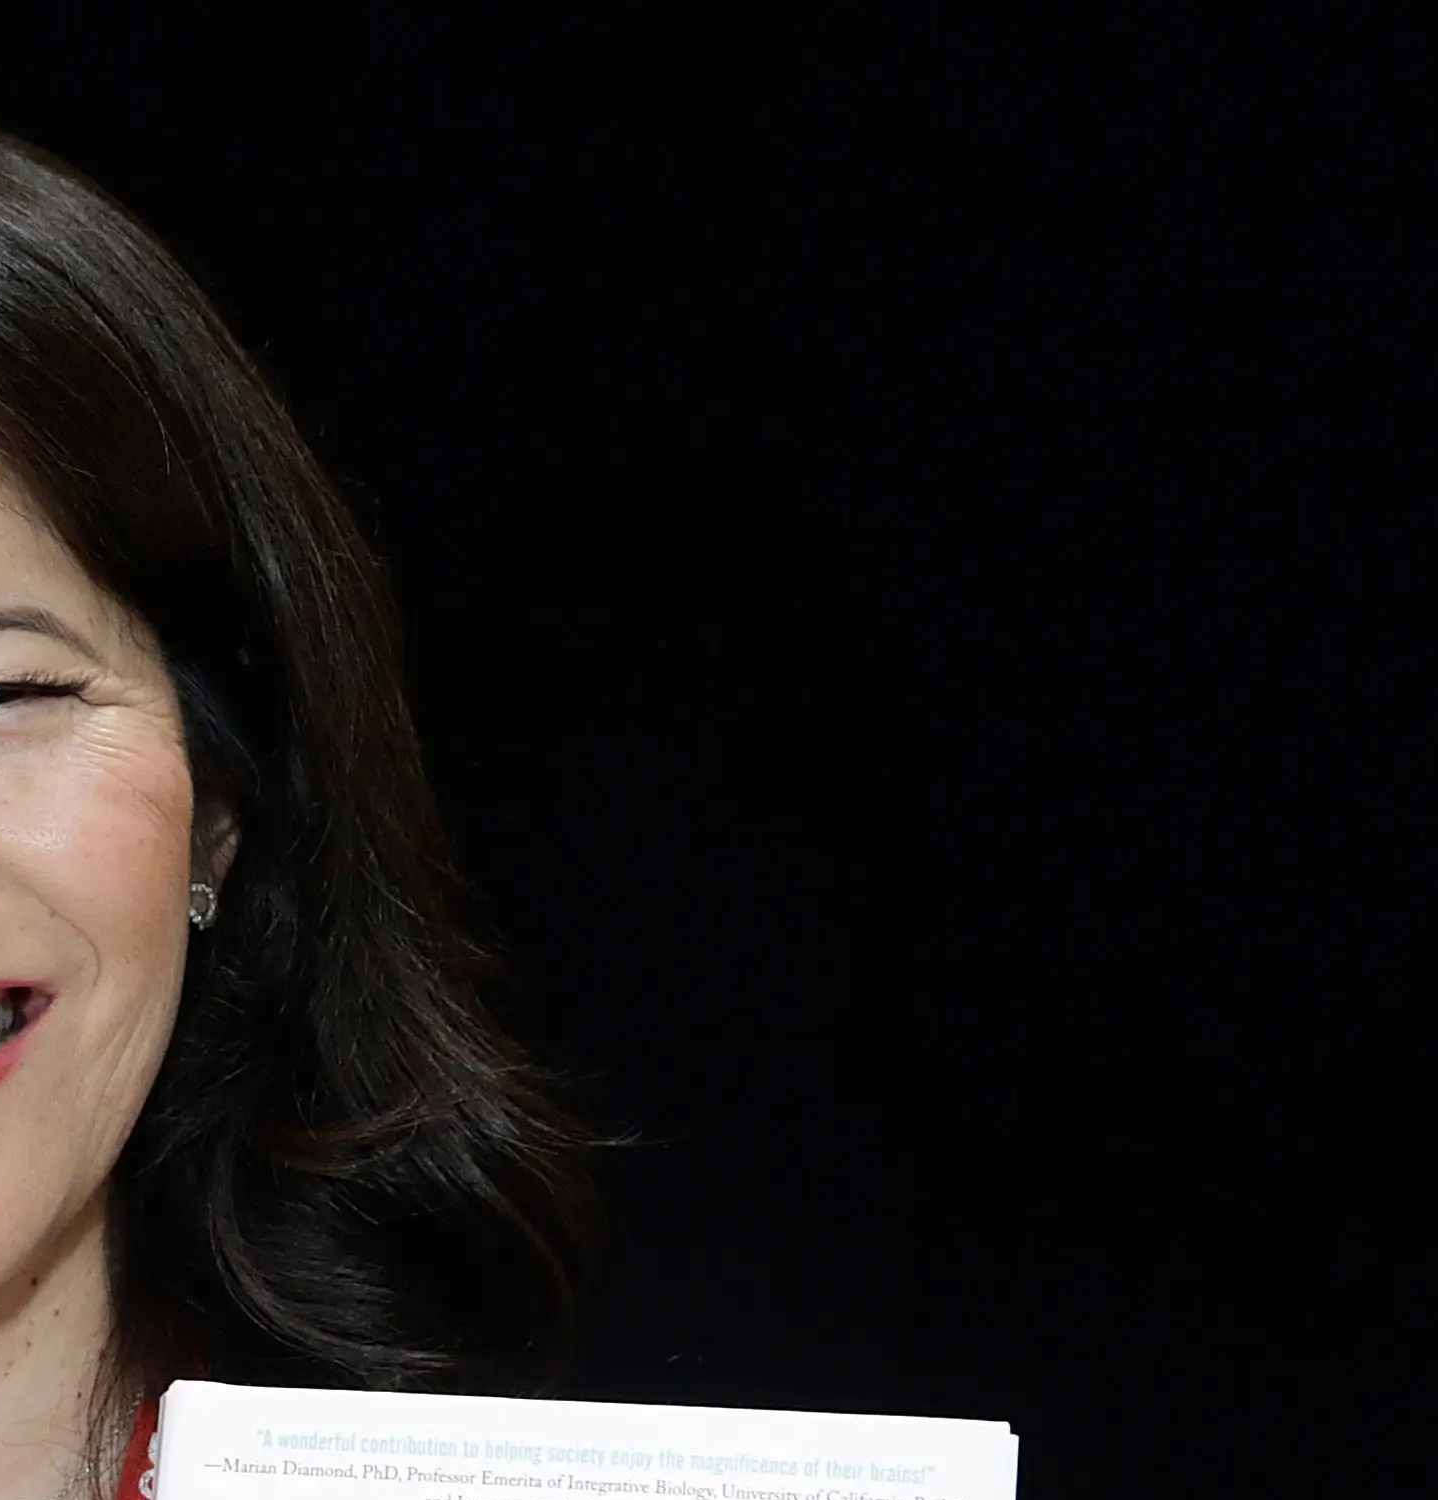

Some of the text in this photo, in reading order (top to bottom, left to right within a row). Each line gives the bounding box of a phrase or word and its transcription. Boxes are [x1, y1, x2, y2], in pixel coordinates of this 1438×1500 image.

[278, 1431, 355, 1453] wonderful
[360, 1432, 458, 1457] contribution
[463, 1440, 479, 1457] to
[484, 1439, 542, 1464] helping
[548, 1445, 604, 1468] society
[611, 1450, 653, 1471] enjoy
[659, 1449, 684, 1470] the
[690, 1453, 797, 1477] magnificence
[804, 1459, 819, 1477] of
[826, 1460, 864, 1479] their
[283, 1460, 357, 1479] Diamond,
[362, 1464, 402, 1482] PhD,
[407, 1467, 475, 1484] Professor
[482, 1471, 542, 1487] Emerita
[547, 1475, 565, 1488] of
[568, 1476, 649, 1495] Integrative
[655, 1481, 717, 1500] Biology,
